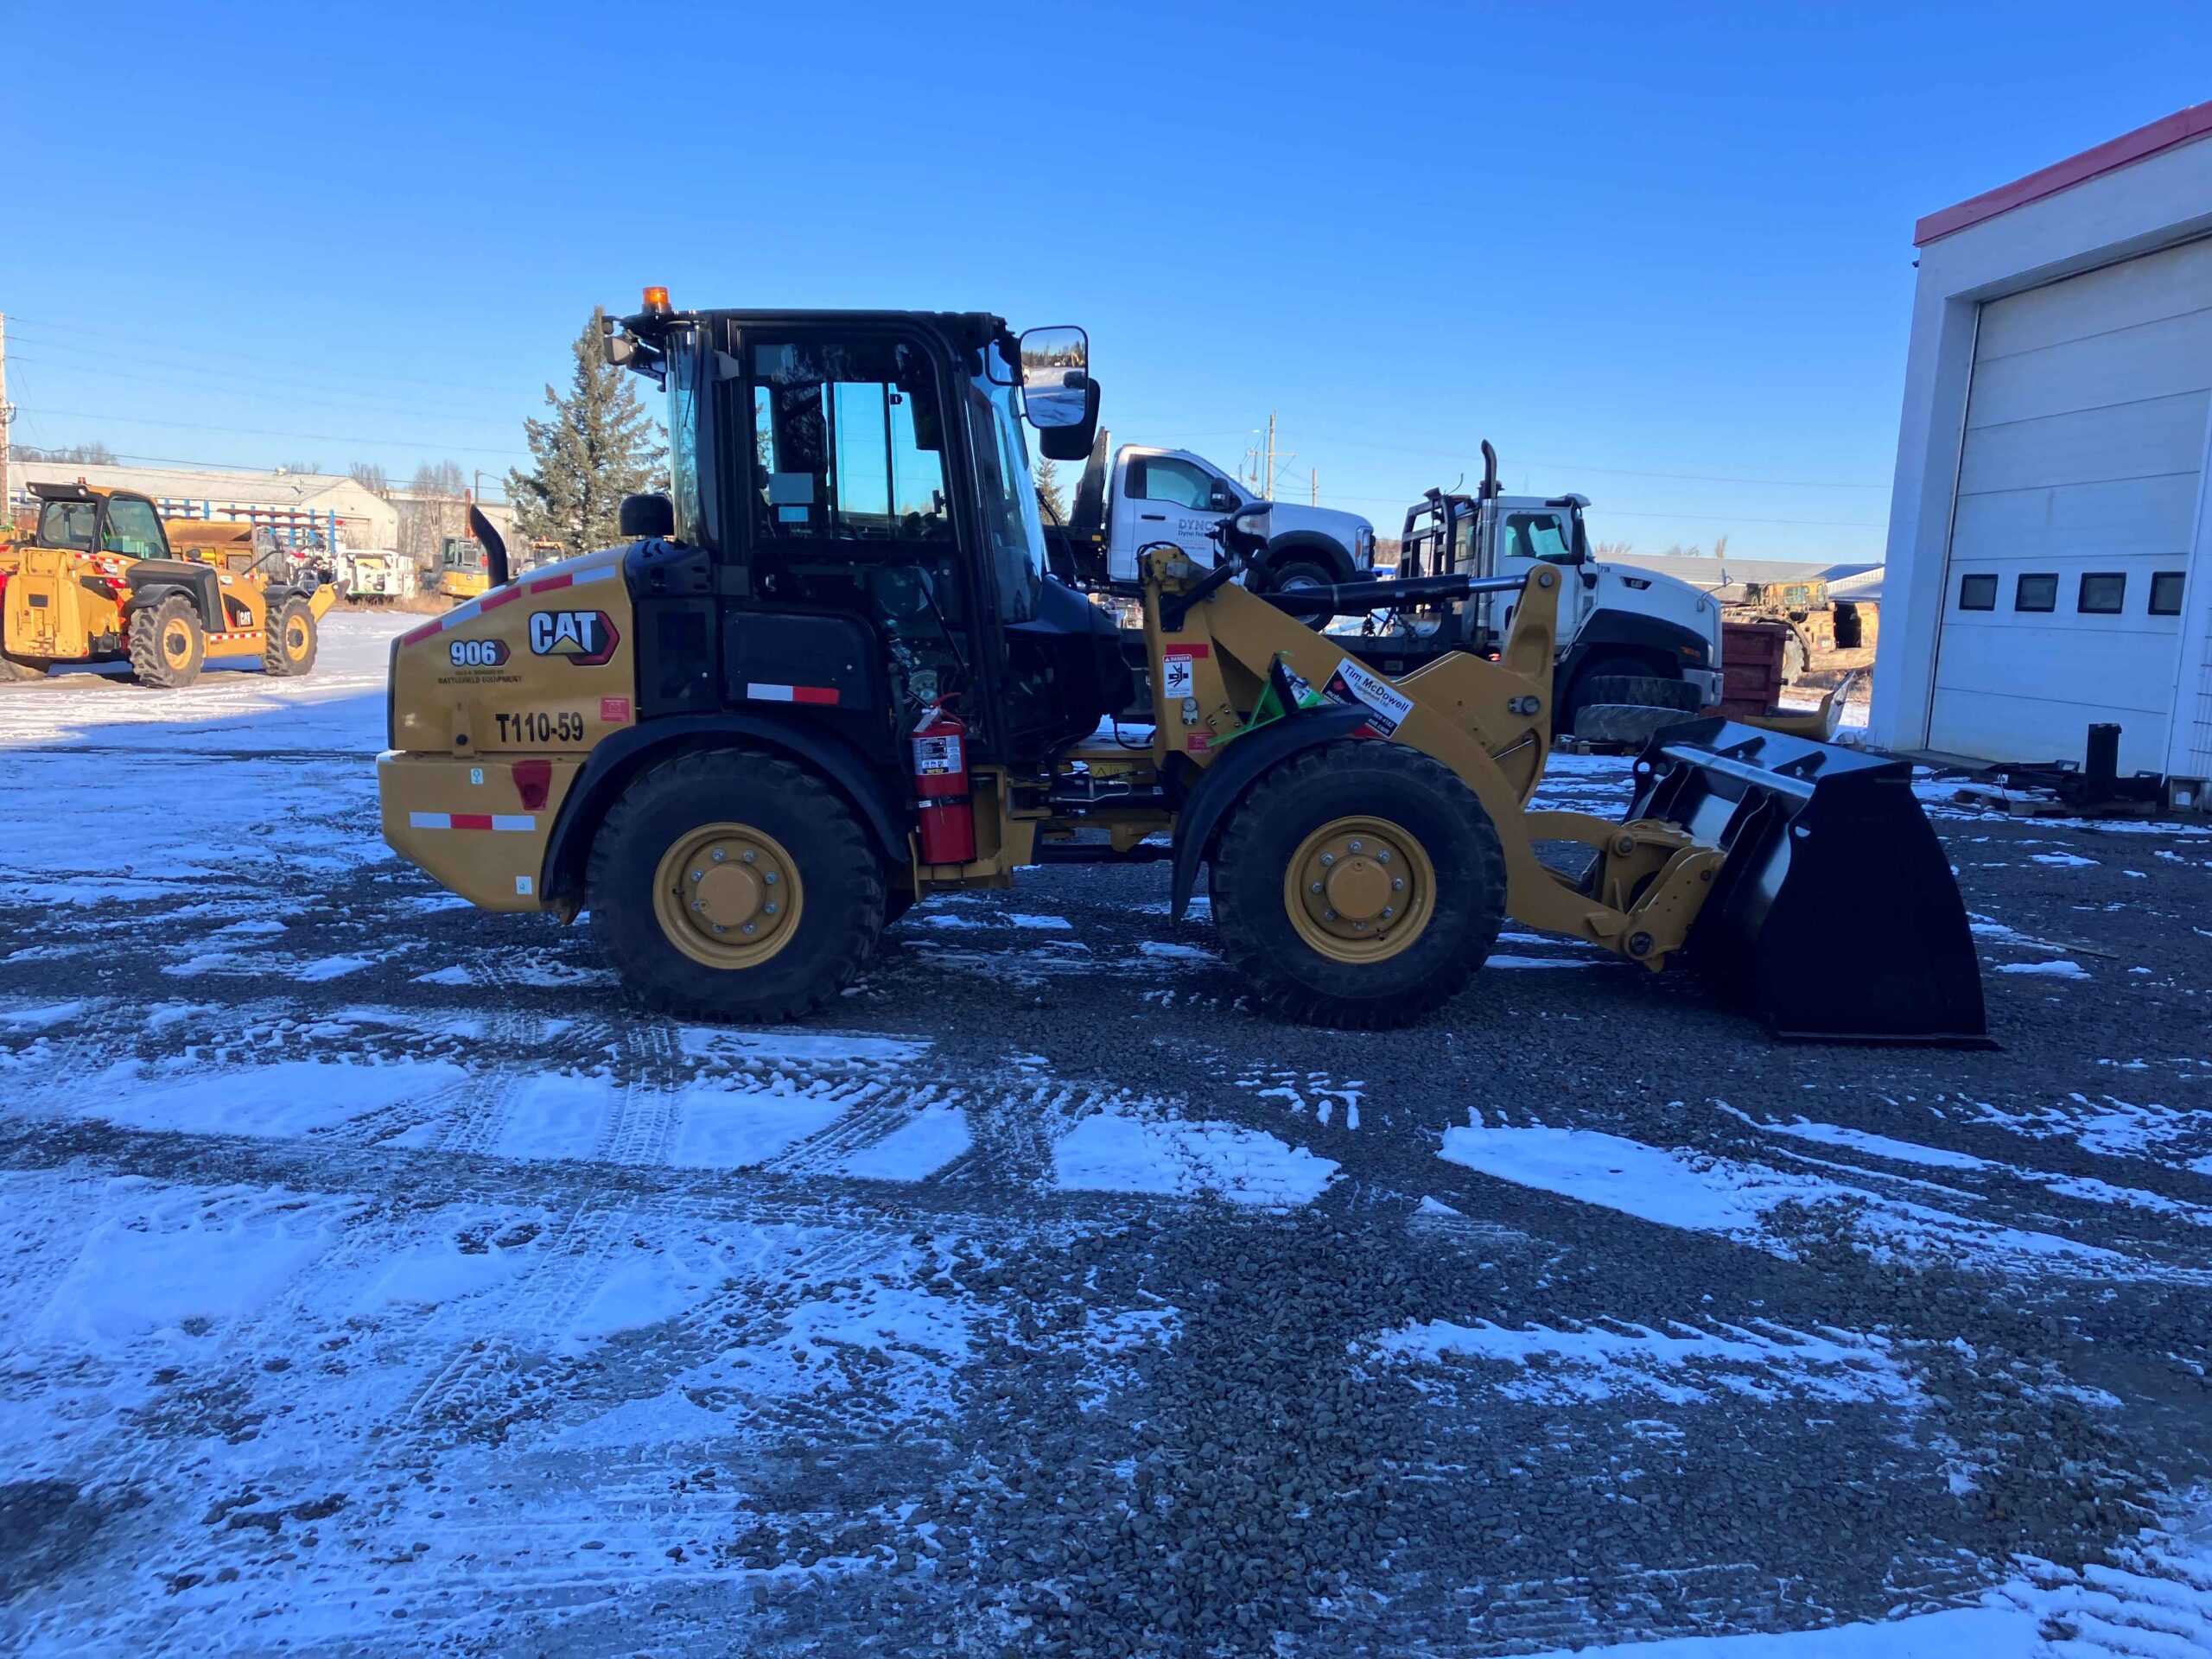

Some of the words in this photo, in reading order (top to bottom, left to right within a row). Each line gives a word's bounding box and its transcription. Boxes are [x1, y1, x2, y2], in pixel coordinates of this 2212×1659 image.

[1179, 518, 1214, 531] DYNO
[240, 612, 251, 625] CAT
[531, 612, 597, 654] CAT
[450, 640, 496, 665] 906
[1344, 664, 1362, 682] Tim
[1363, 677, 1409, 712] McDowell
[1353, 682, 1381, 702] Equipment
[495, 712, 584, 742] T110-59
